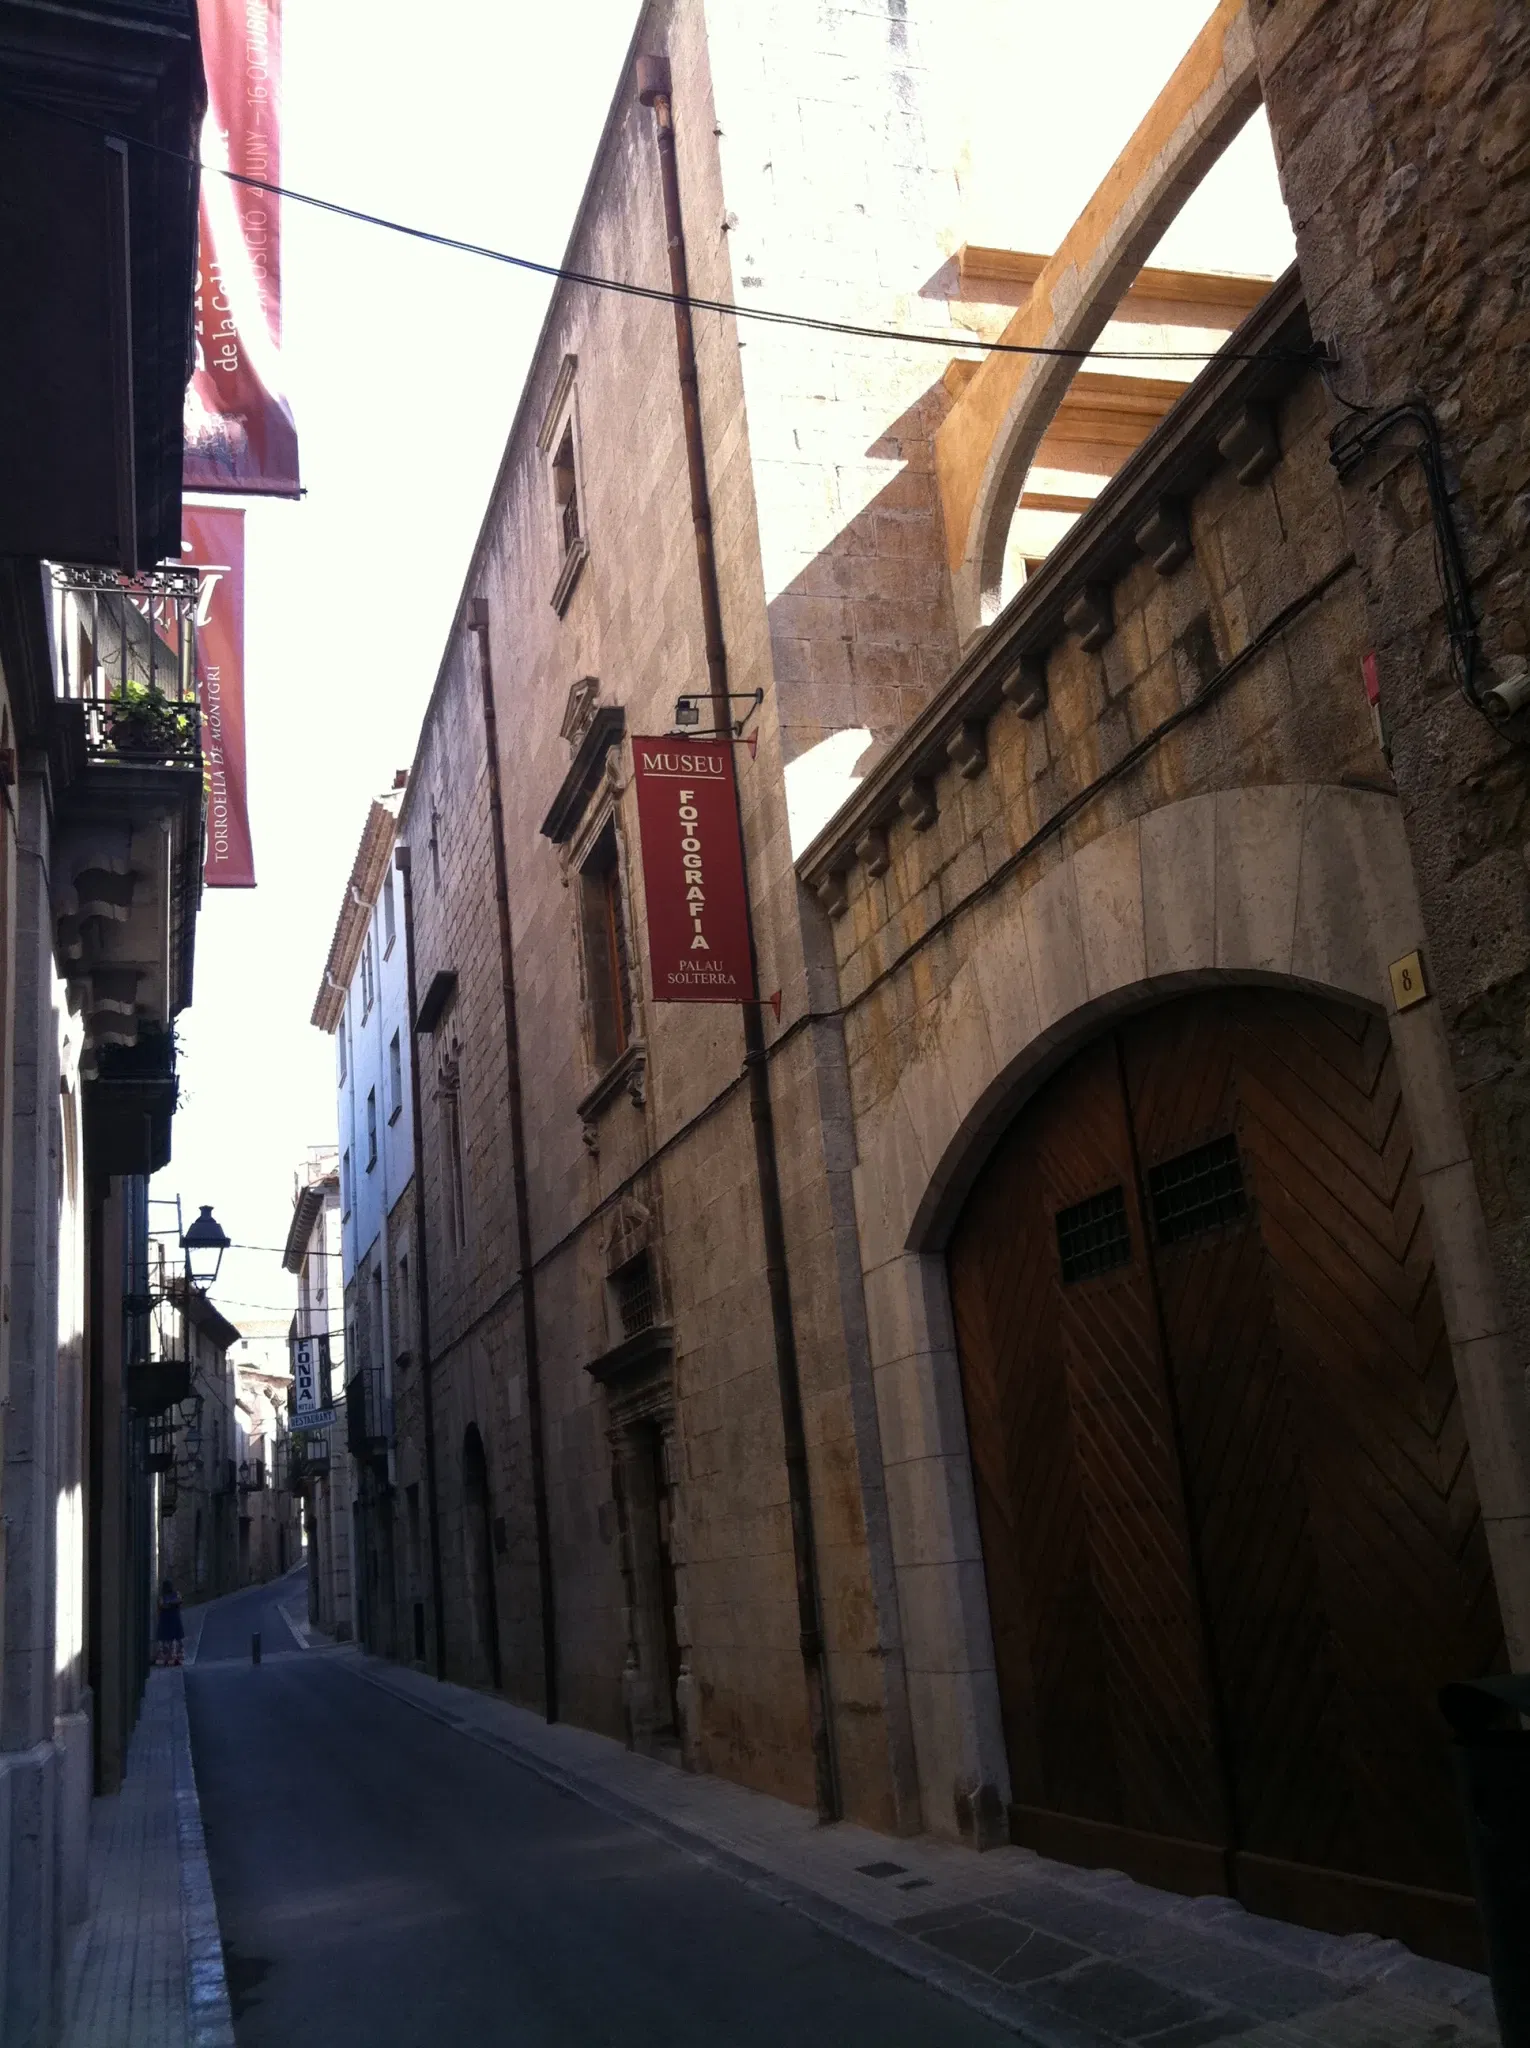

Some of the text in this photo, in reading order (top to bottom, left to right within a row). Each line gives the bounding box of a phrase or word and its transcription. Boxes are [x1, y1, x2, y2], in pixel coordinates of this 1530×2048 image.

[247, 87, 268, 107] 16
[246, 130, 268, 180] JUNY
[213, 344, 239, 372] de
[211, 745, 224, 765] DE
[642, 753, 724, 774] MUSEU
[213, 771, 229, 863] TORROELLA
[679, 790, 710, 950] FOTOGRAFIA
[679, 960, 724, 972] PALAU
[667, 972, 737, 984] SOLTERRA
[1402, 968, 1412, 991] 8
[297, 1340, 313, 1400] FONDA
